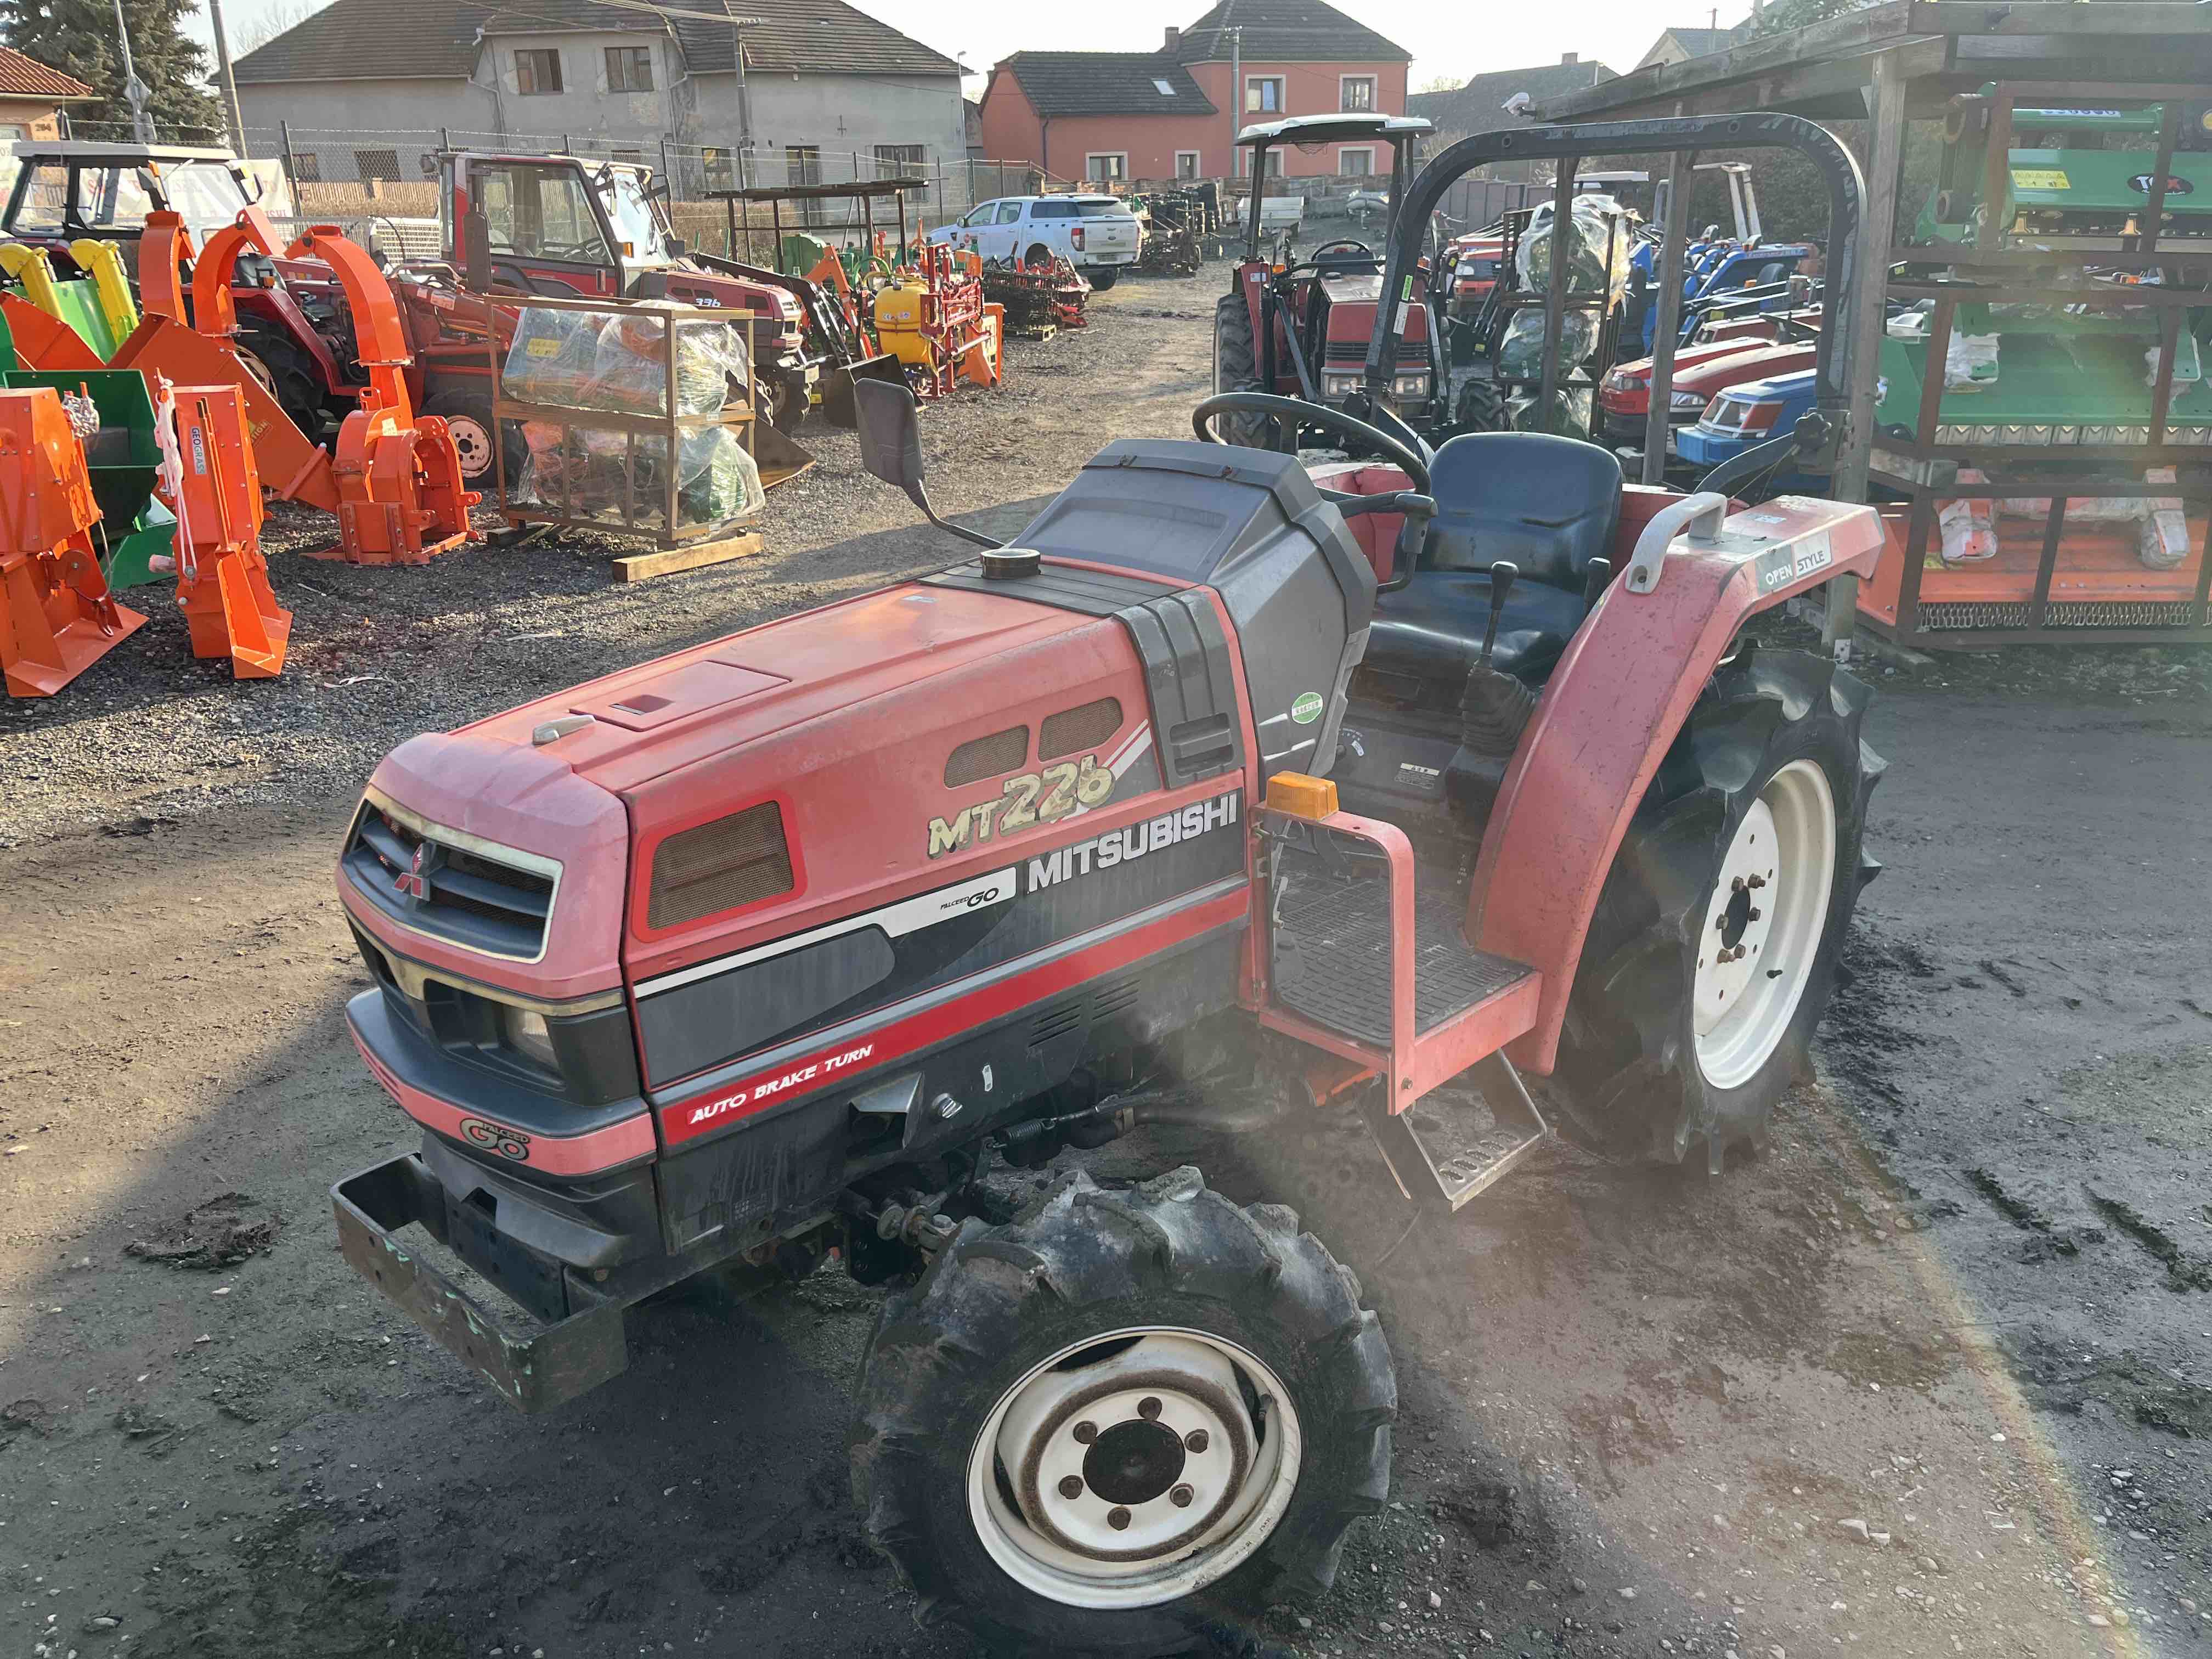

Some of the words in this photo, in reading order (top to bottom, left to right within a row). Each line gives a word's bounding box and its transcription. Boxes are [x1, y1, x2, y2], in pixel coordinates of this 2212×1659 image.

[192, 427, 206, 475] GEOGRASS
[1765, 563, 1793, 585] OPEN
[1797, 550, 1825, 572] STYLE
[928, 754, 1115, 860] MT226
[1028, 793, 1238, 894] MITSUBISHI
[689, 1093, 747, 1125] AUTO
[754, 1064, 818, 1100] BRAKE
[825, 1044, 873, 1071] TURN
